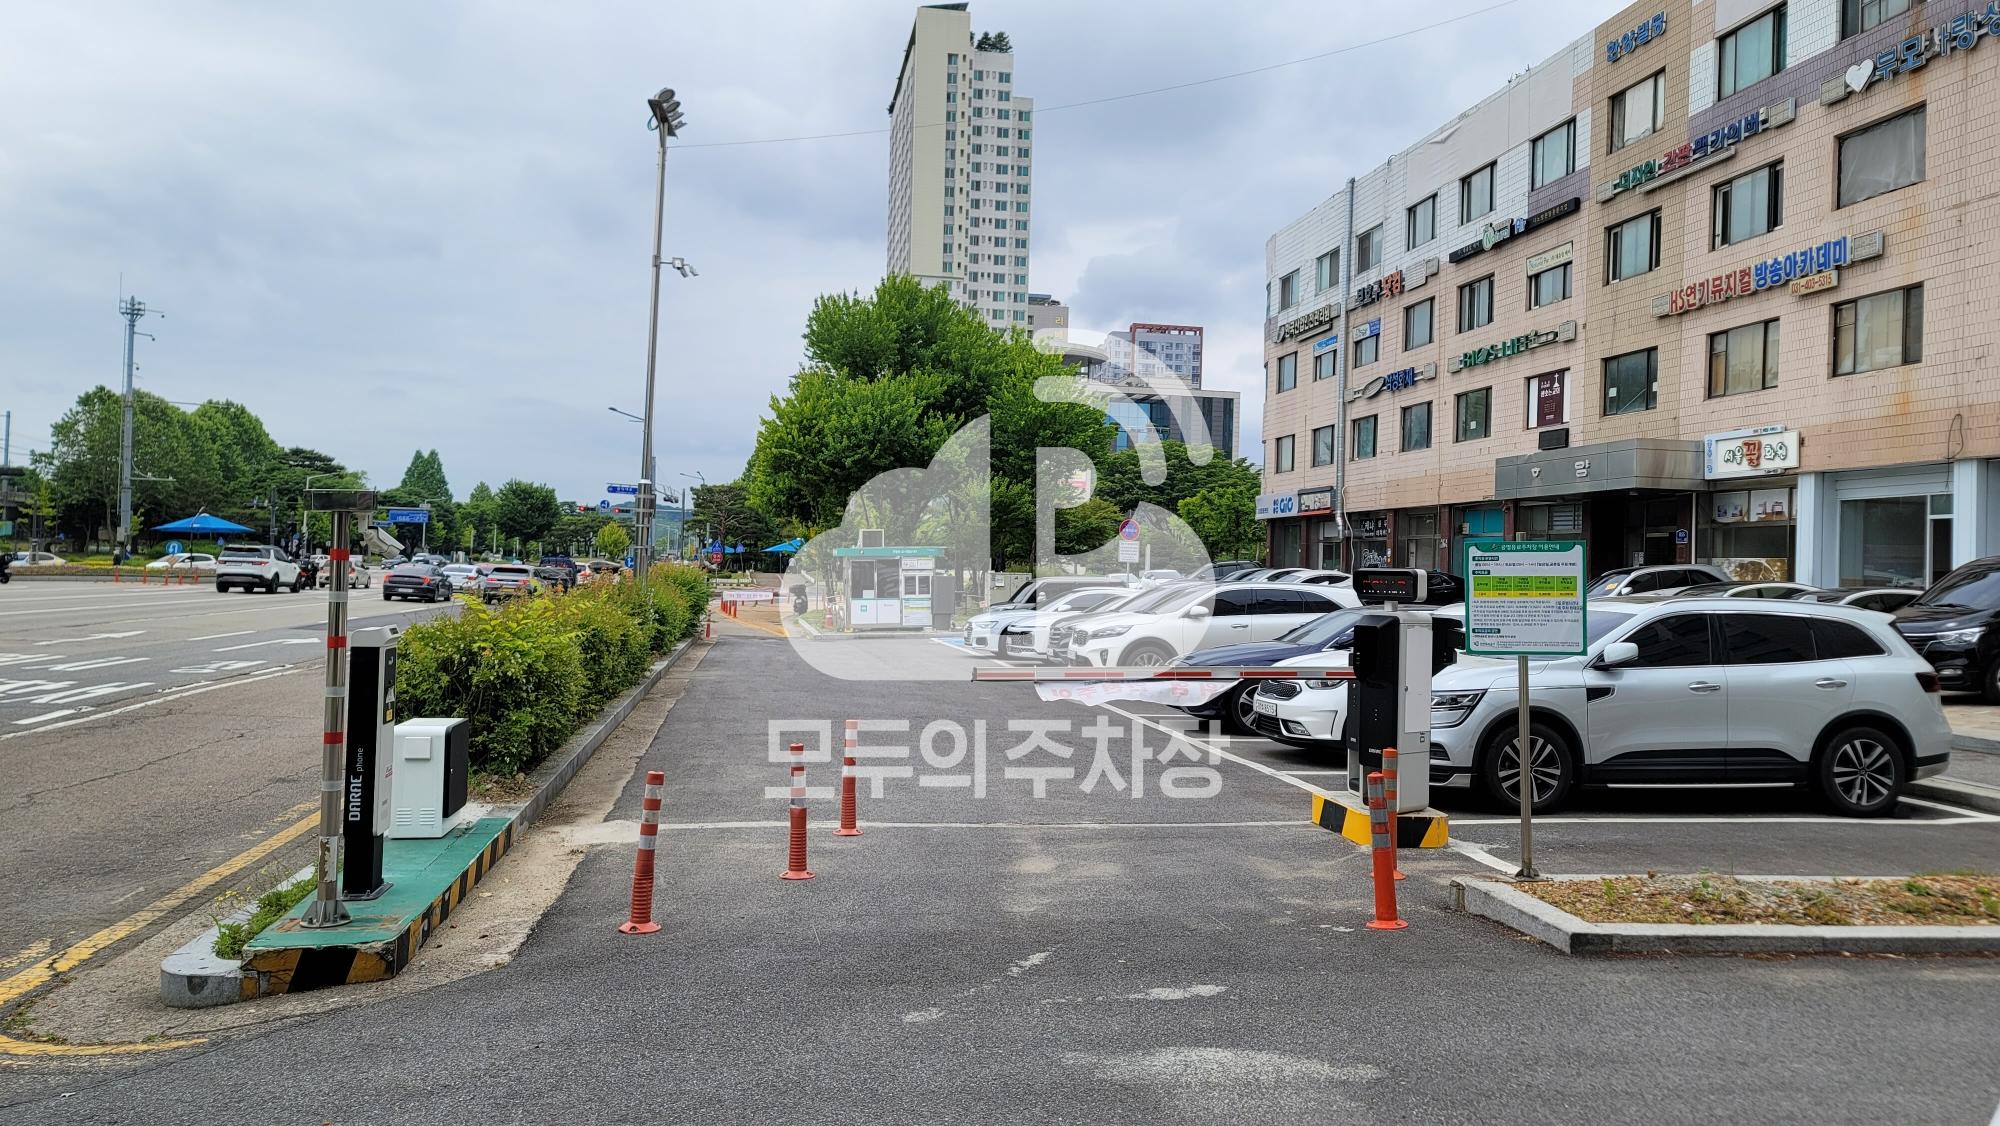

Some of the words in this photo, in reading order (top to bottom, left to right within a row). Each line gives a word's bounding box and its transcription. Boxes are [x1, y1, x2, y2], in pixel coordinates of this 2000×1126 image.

[1669, 266, 1752, 314] HS연기뮤지컬
[1754, 235, 1849, 290] 방송아카데미
[1790, 272, 1834, 295] 031-403-5315
[1724, 446, 1743, 465] 서울
[1743, 440, 1761, 467] 꽃
[1763, 442, 1787, 460] 화원
[356, 747, 364, 772] phone
